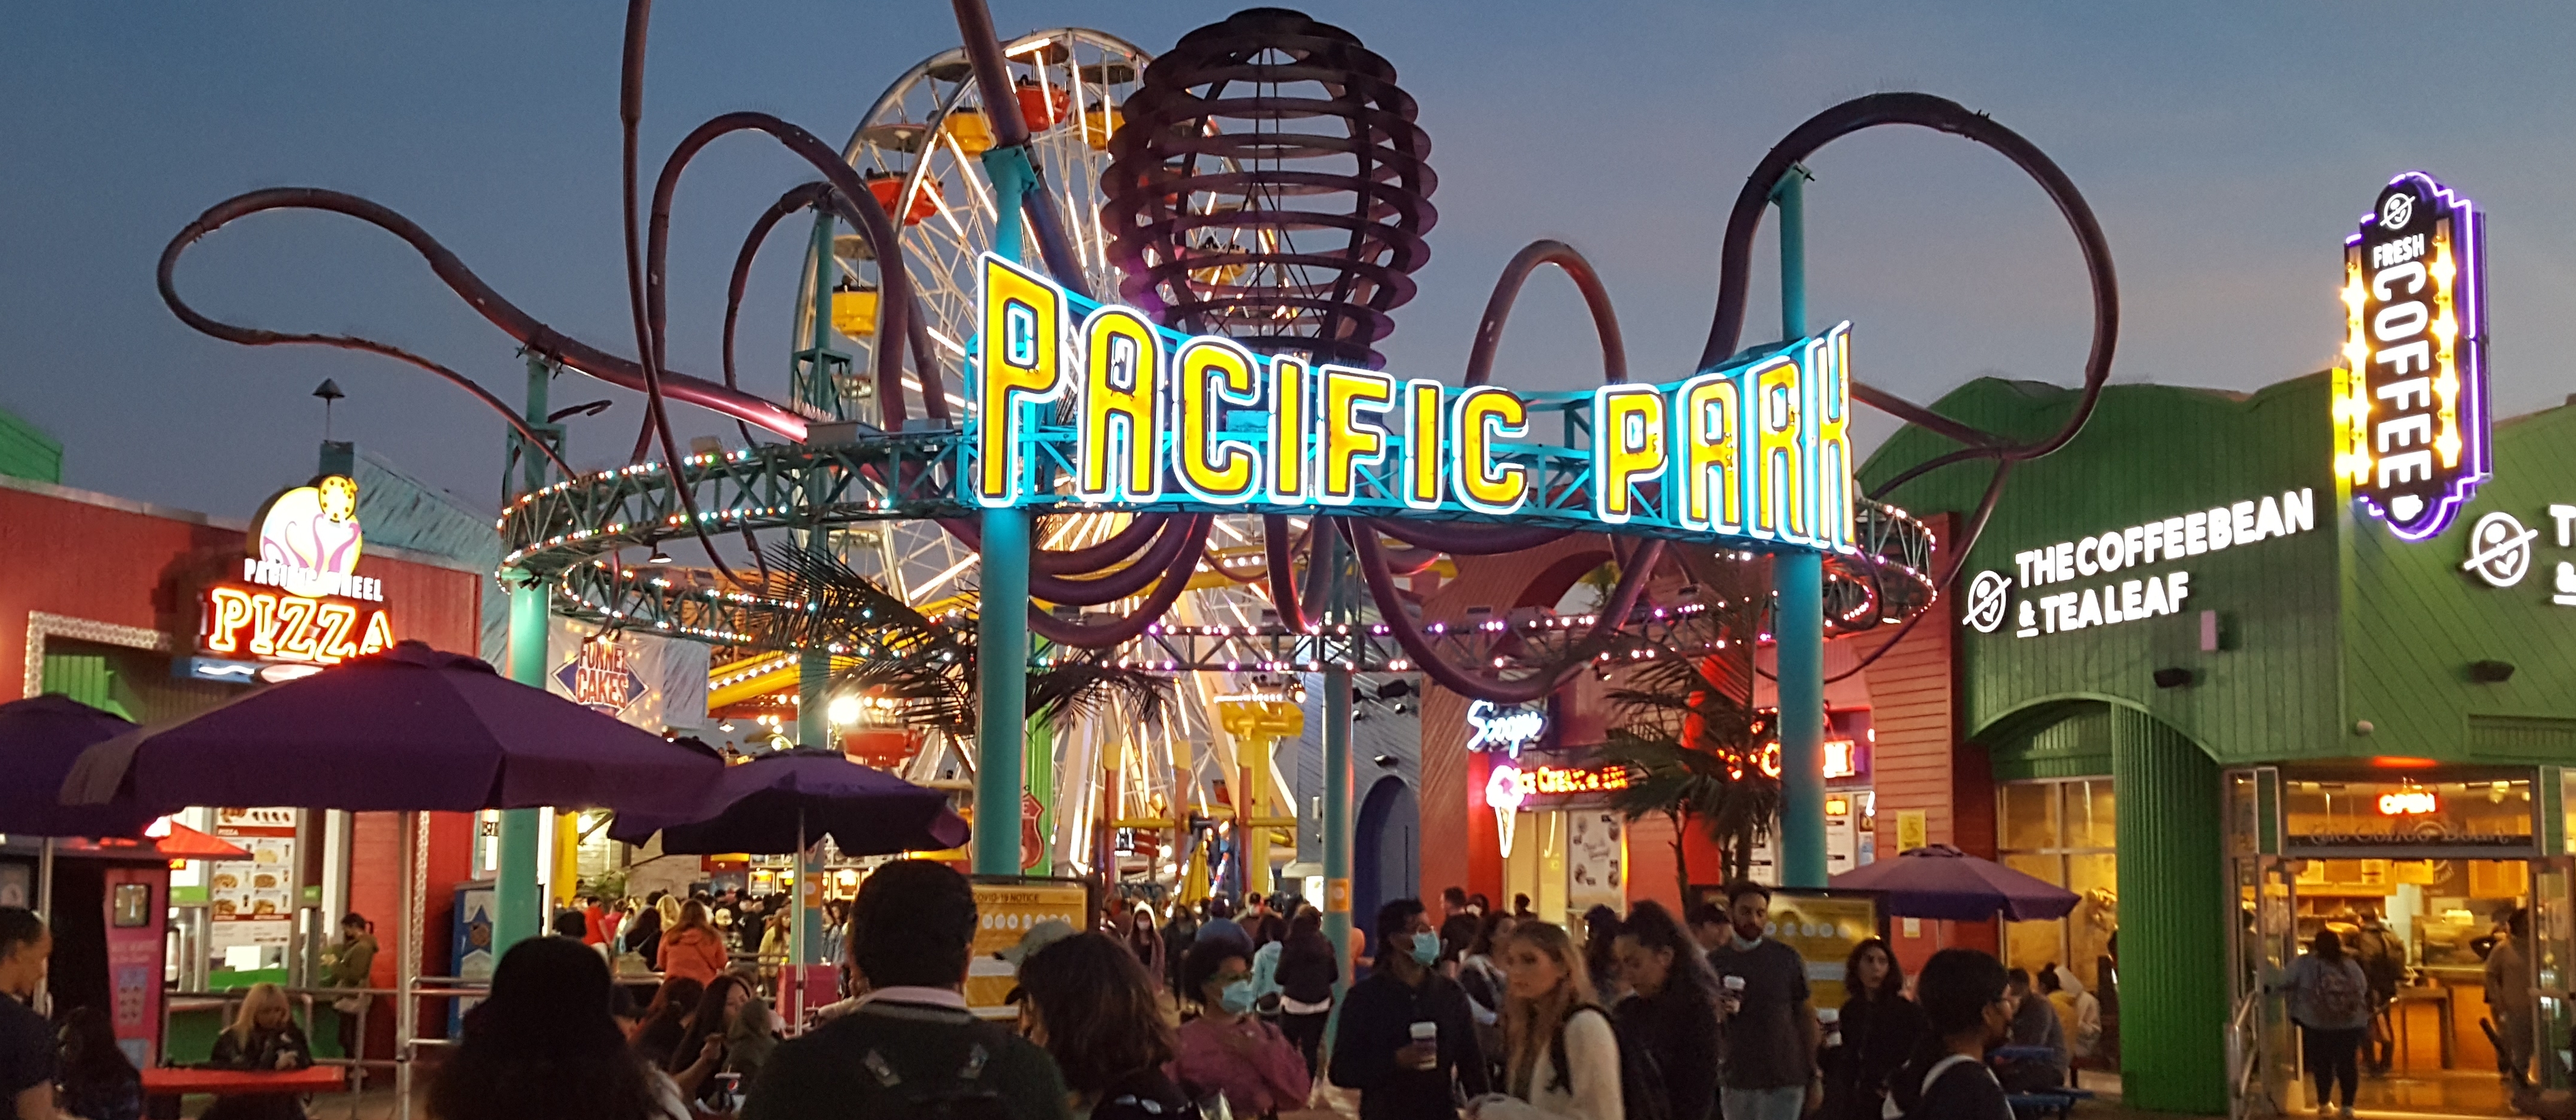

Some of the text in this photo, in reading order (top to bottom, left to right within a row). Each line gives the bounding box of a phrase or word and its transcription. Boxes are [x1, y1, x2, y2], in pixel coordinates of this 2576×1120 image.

[2373, 233, 2425, 269] FRESH
[2373, 261, 2432, 489] COFFEE
[978, 252, 1857, 554] PACIFIC PARK
[2015, 487, 2314, 589] THE COFFEE BEAN
[326, 571, 383, 602] WHEEL
[2017, 571, 2189, 638] & TEA LEAF
[209, 587, 394, 664] PIZZA
[579, 641, 628, 674] FUNNEL
[576, 668, 629, 709] CAKES
[2378, 793, 2437, 815] OPEN
[1010, 893, 1039, 902] NOTICE
